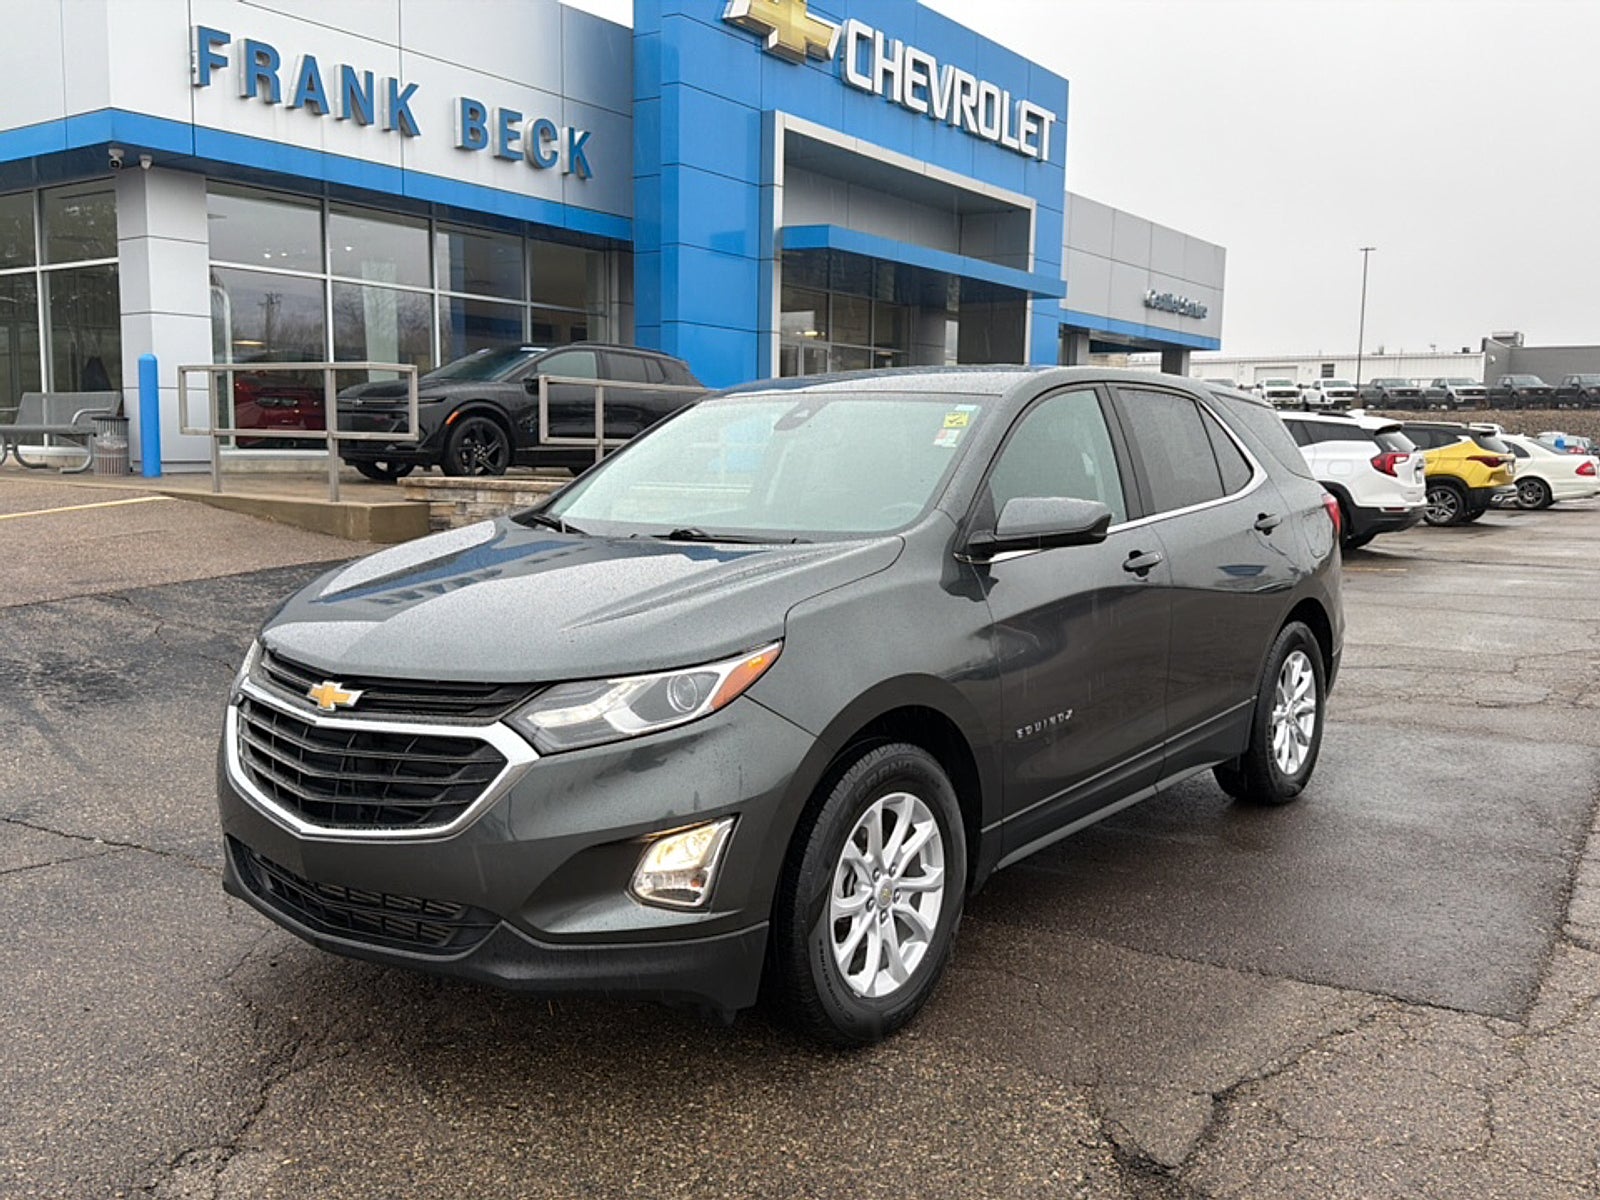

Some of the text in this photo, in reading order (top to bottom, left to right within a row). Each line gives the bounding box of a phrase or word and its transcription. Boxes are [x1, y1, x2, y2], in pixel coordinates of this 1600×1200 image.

[192, 24, 593, 180] FRANK BECK
[840, 18, 1056, 162] CHEVROLET
